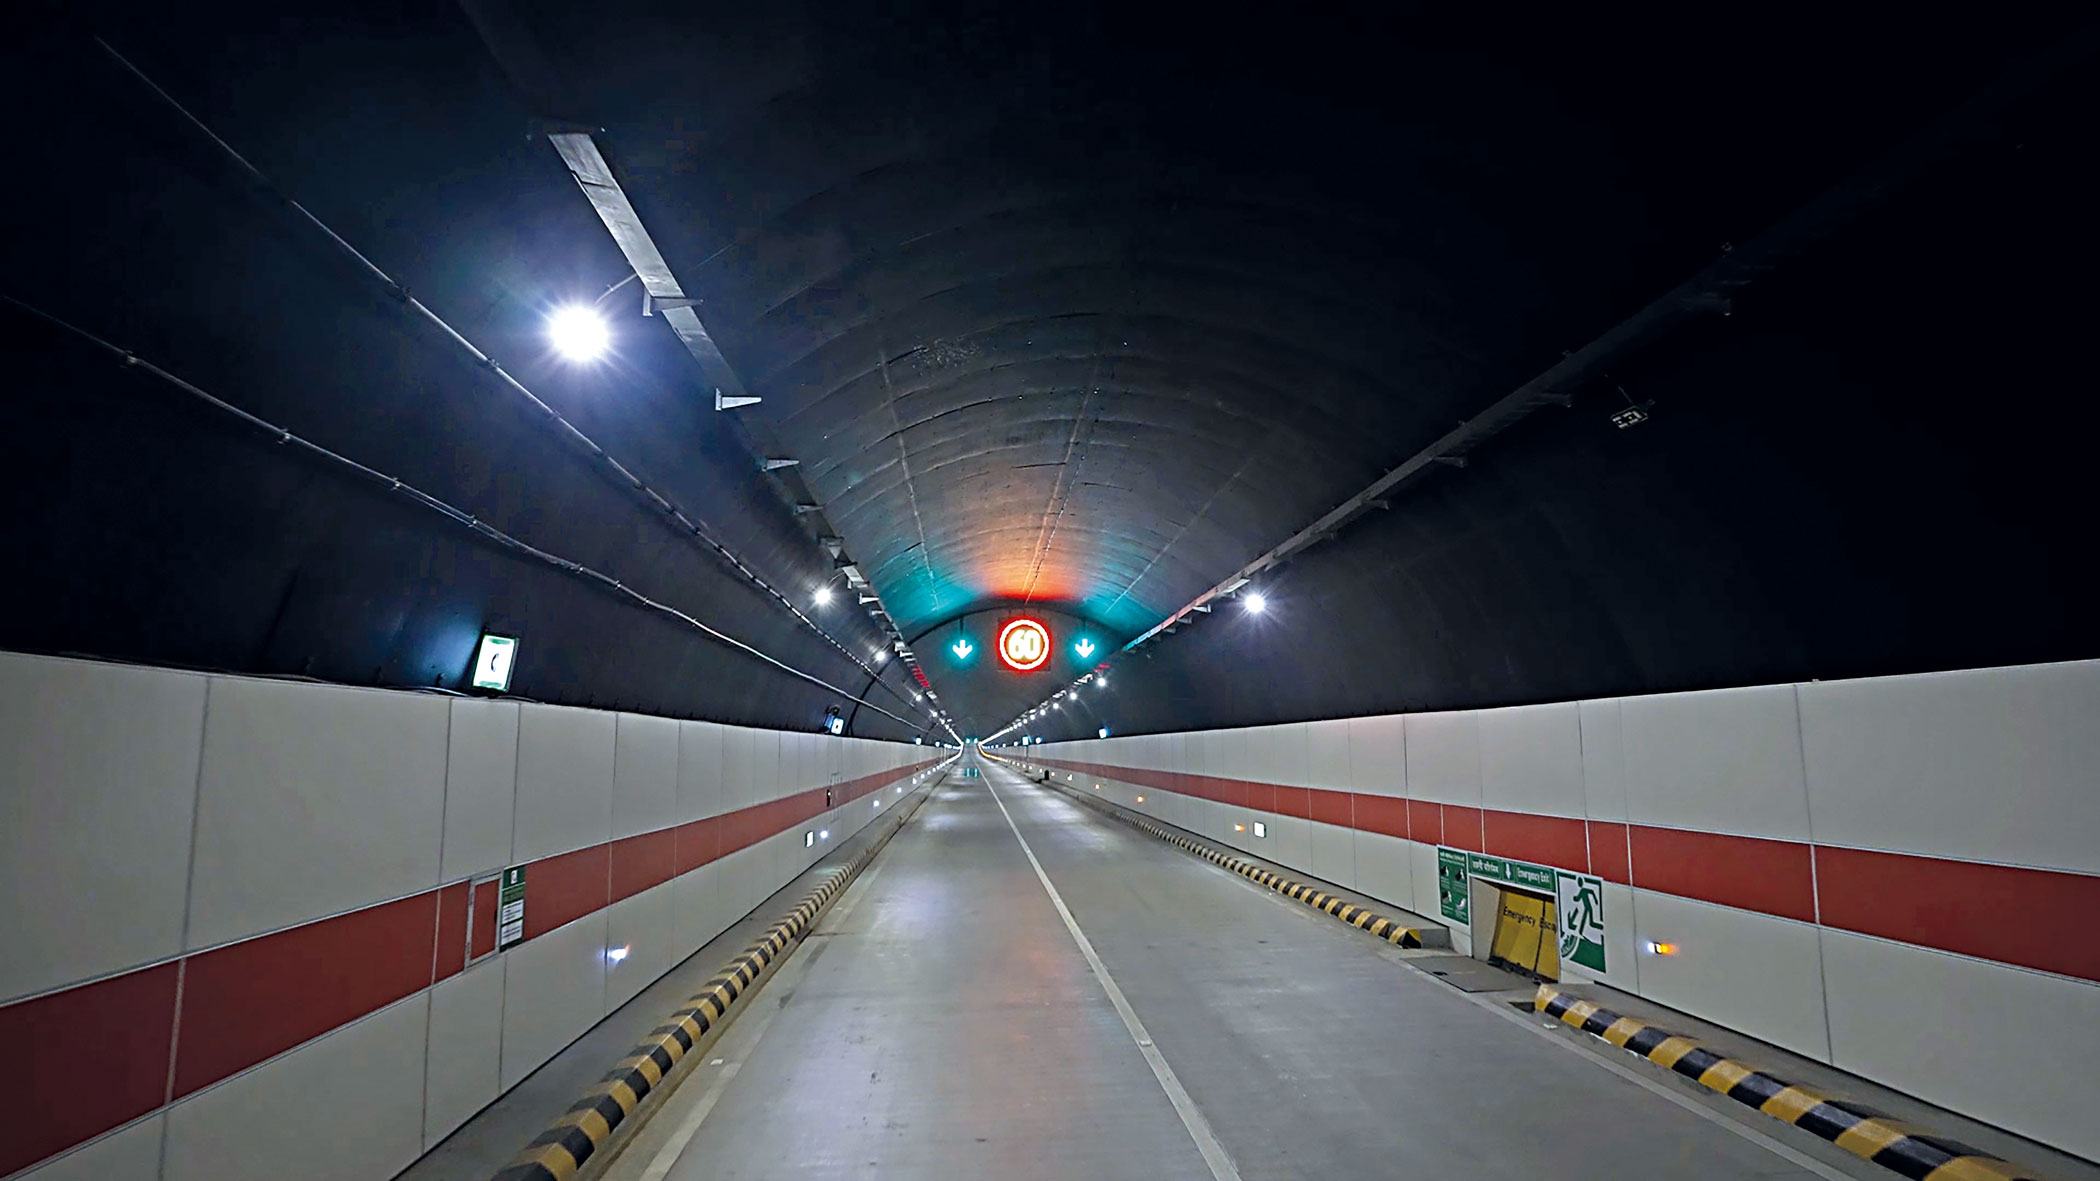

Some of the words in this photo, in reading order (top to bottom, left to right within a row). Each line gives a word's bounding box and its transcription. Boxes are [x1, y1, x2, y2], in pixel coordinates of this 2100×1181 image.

[1008, 629, 1041, 660] 60
[1517, 867, 1539, 883] Emergency
[1540, 871, 1550, 883] Exit
[1503, 905, 1535, 928] Emergency
